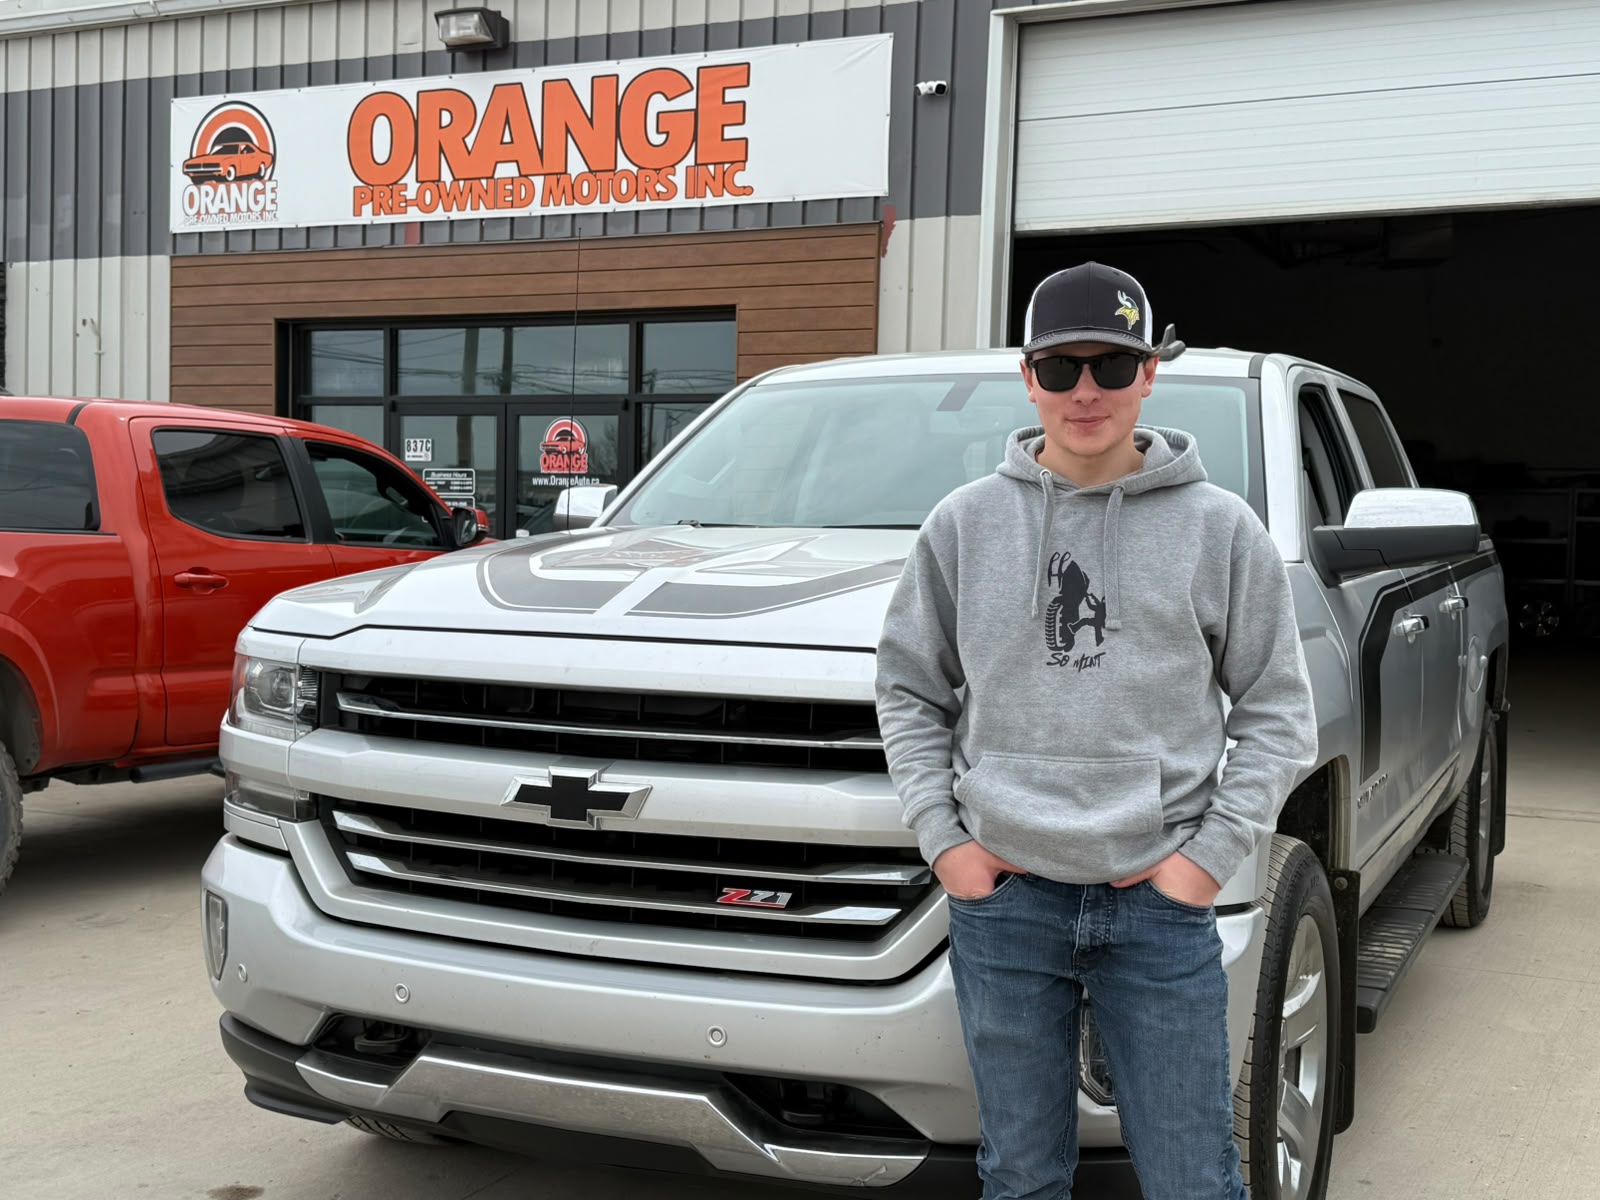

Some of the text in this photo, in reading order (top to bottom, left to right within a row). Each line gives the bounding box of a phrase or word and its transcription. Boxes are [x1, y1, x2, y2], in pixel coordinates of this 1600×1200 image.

[347, 62, 751, 186] ORANGE
[353, 161, 754, 217] PRE-OWNED MOTORS INC.
[182, 180, 278, 216] ORANGE
[230, 211, 262, 224] MOTORS
[406, 440, 431, 452] 837C
[541, 453, 588, 468] ORANGE
[532, 475, 600, 487] www.OrangeAuto.ca
[1046, 652, 1070, 667] SO
[716, 888, 793, 908] Z71
